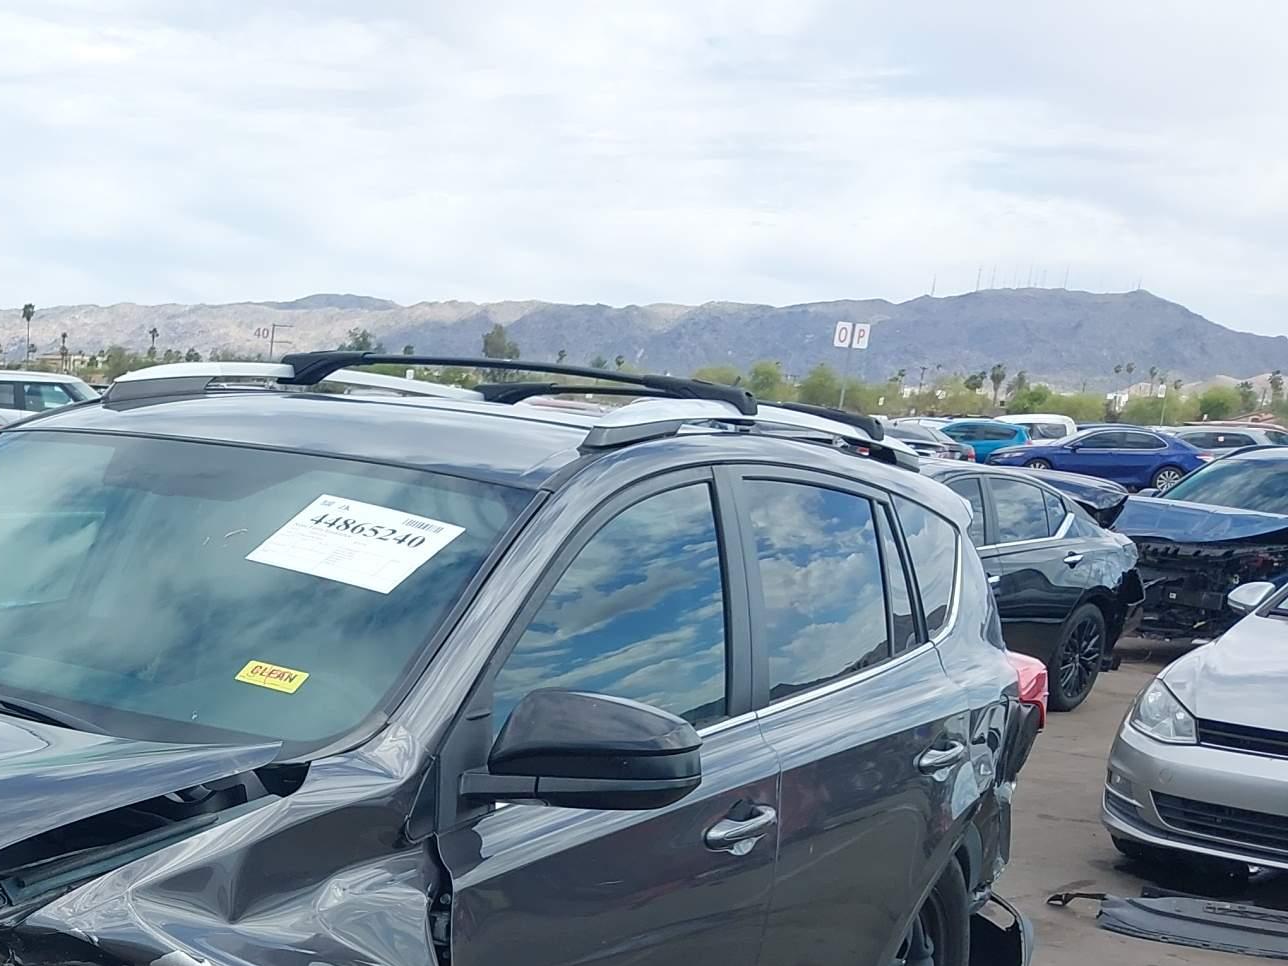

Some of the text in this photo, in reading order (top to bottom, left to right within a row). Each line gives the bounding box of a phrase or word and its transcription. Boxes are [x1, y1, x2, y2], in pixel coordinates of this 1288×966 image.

[254, 327, 270, 339] 40
[856, 328, 866, 345] P
[310, 512, 426, 549] 44865240
[250, 665, 298, 683] CLEAN
